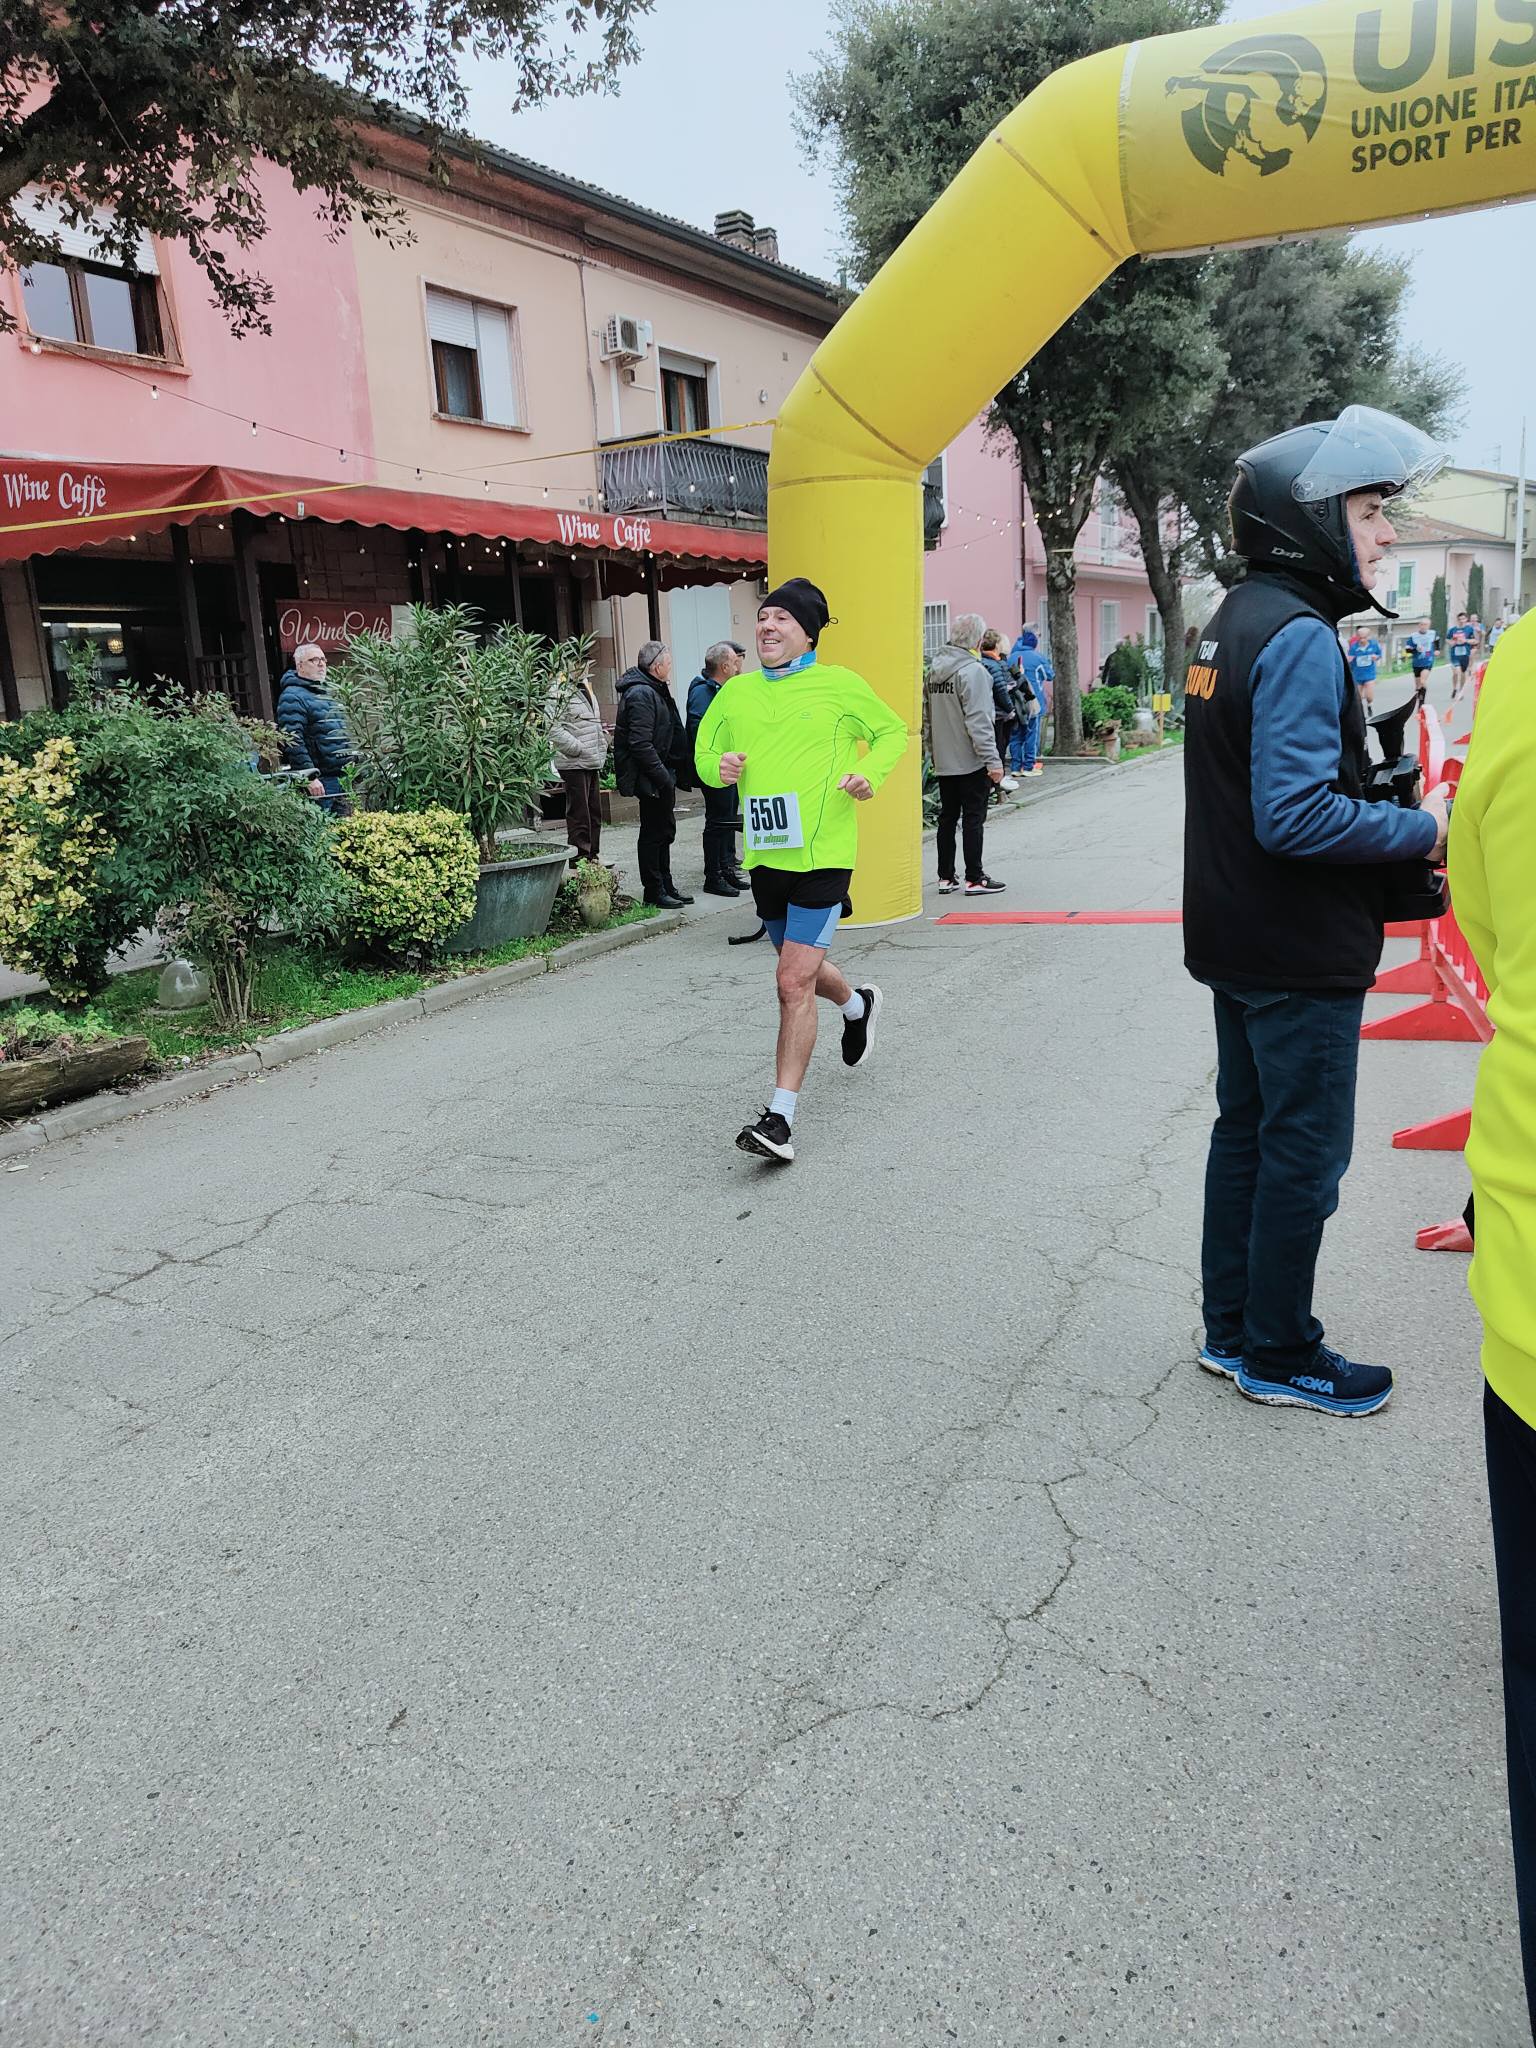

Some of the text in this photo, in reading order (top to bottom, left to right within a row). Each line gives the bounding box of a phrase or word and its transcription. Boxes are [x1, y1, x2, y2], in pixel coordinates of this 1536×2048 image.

[1351, 87, 1478, 139] UNIONE
[1351, 117, 1522, 173] SPORT PER
[3, 472, 107, 516] Wine Caffè
[557, 513, 652, 551] Wine Caffè
[750, 796, 788, 832] 550
[1289, 1375, 1334, 1395] HOKA
